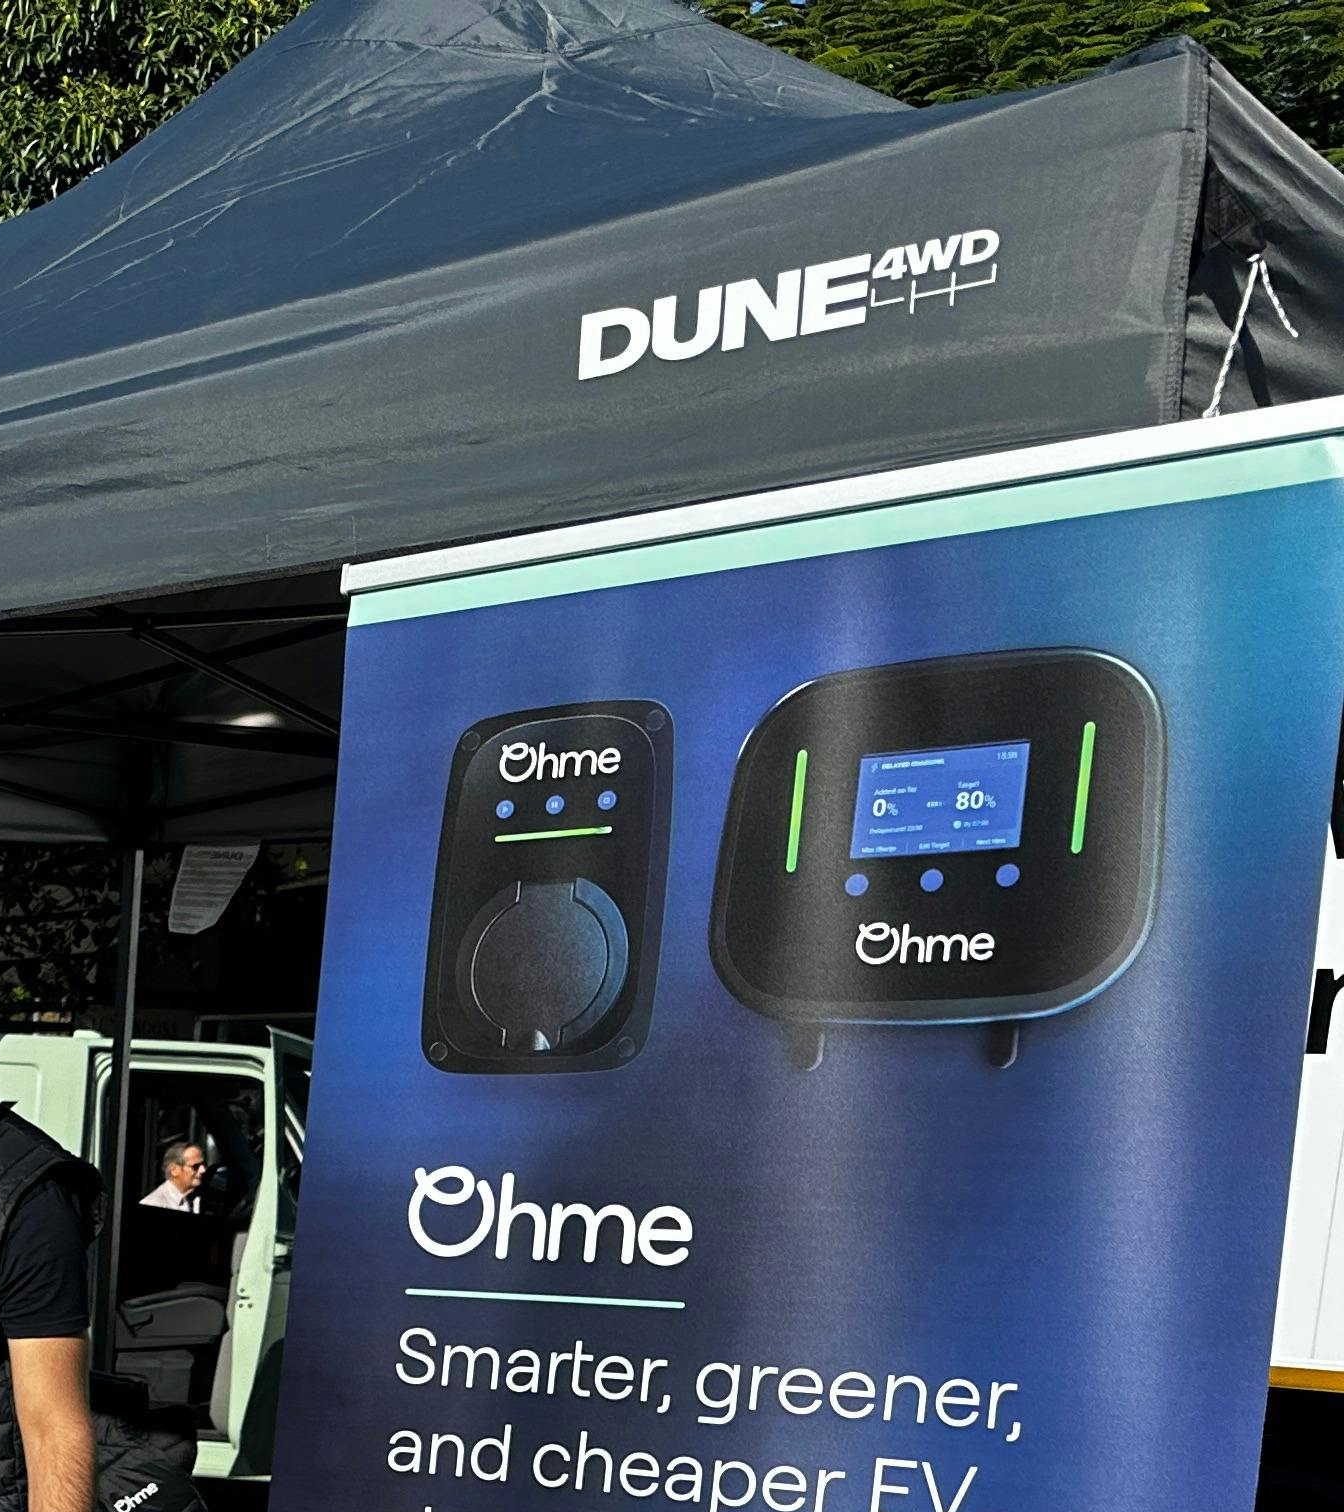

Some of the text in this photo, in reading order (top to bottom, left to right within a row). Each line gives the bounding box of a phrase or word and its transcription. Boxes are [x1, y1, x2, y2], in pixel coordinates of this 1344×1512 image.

[578, 228, 1000, 381] DUNE 4WD
[499, 742, 621, 783] Ohme
[872, 798, 898, 817] 0%
[955, 790, 997, 811] 80%
[855, 922, 996, 966] Ohme
[407, 1165, 693, 1266] Ohme
[395, 1327, 1021, 1442] Smarter, greener,
[387, 1423, 513, 1482] and
